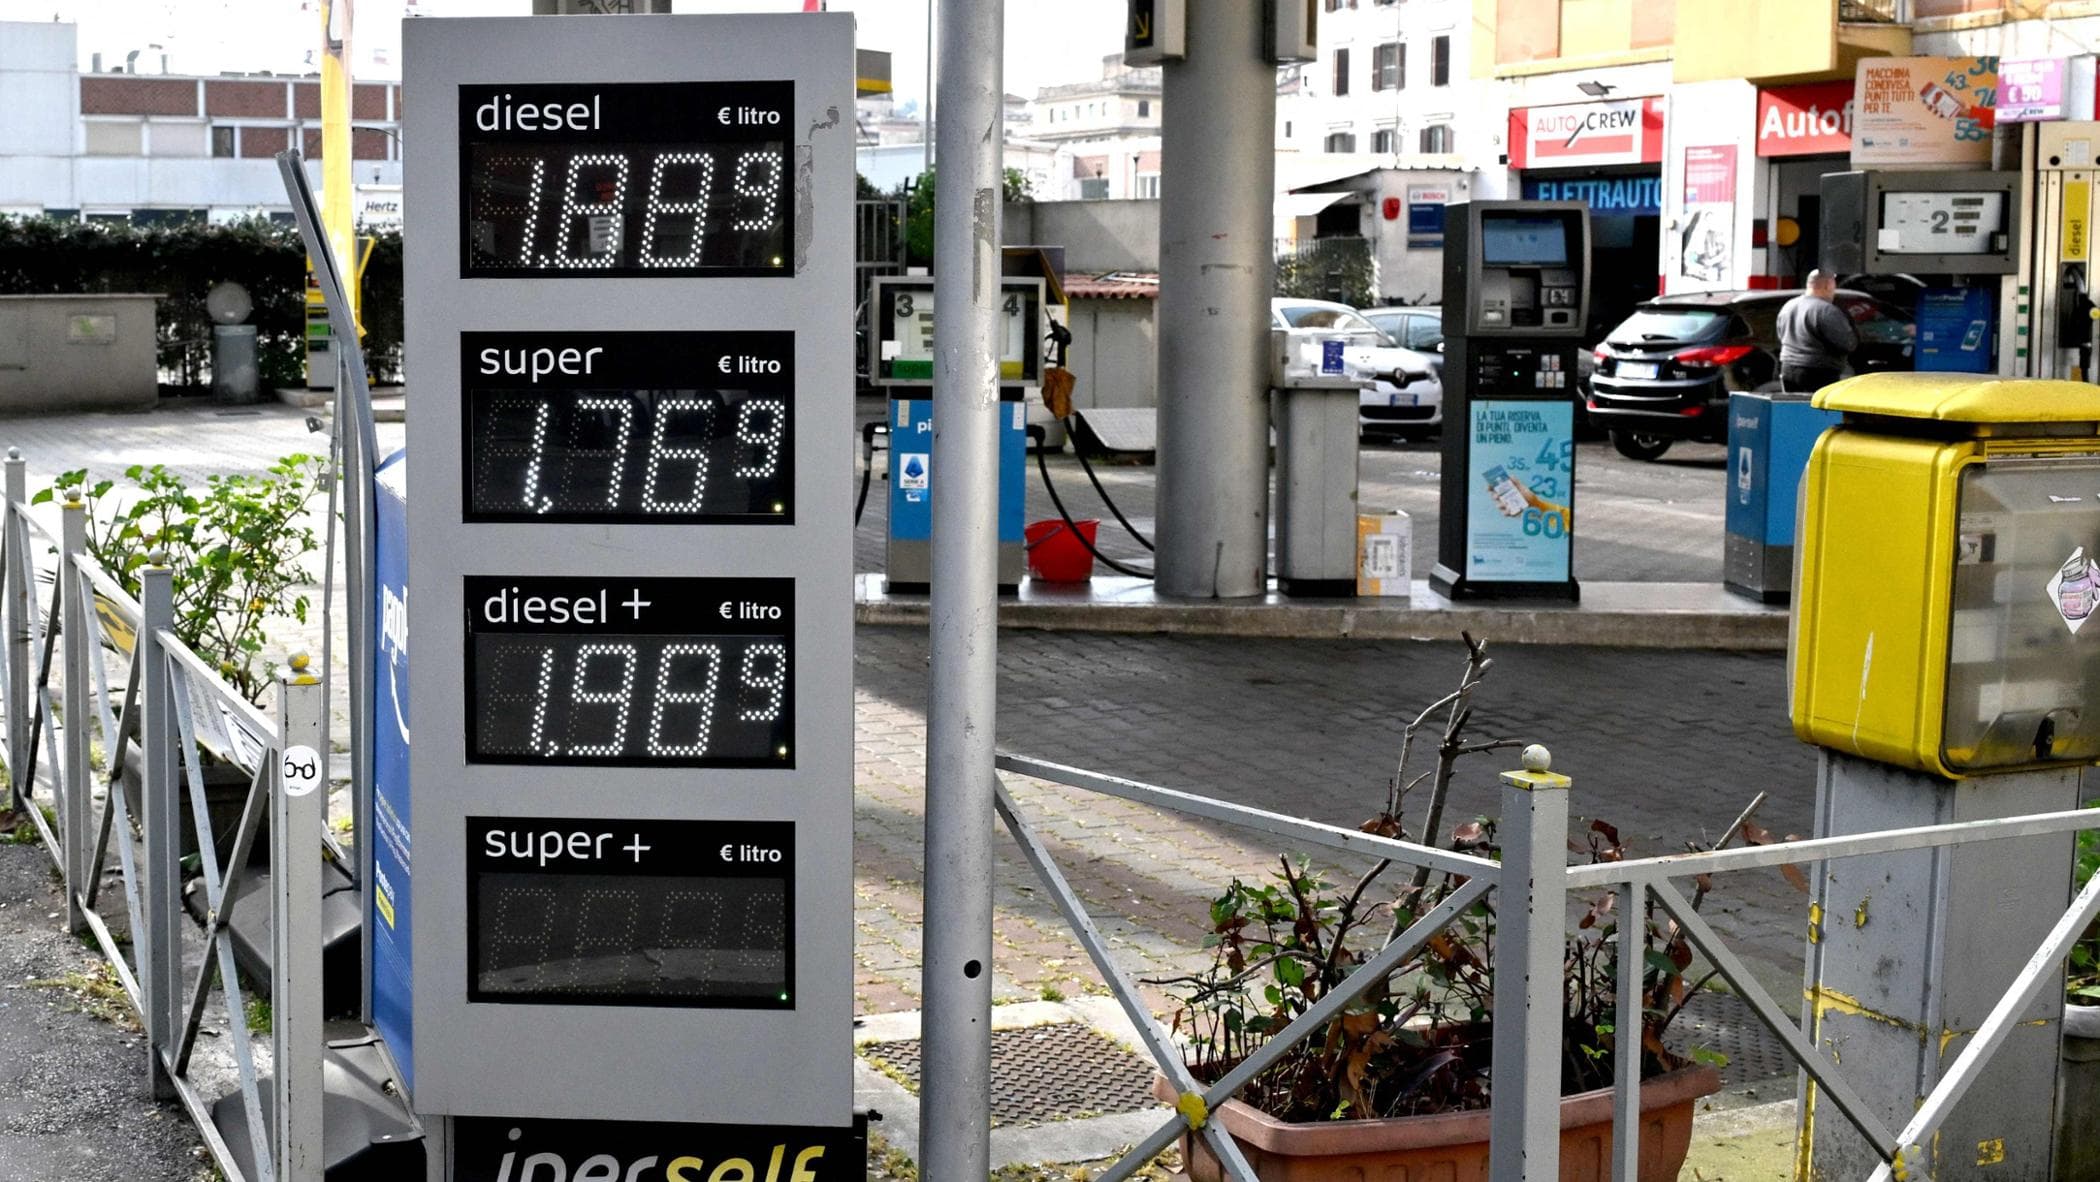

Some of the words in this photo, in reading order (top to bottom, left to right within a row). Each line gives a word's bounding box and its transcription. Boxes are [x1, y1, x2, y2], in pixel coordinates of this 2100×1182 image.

[476, 94, 600, 131] diesel
[717, 107, 731, 125] €
[738, 106, 781, 125] litro
[1536, 115, 1577, 134] AUTO
[1586, 110, 1636, 131] CREW
[365, 200, 398, 212] Hertz
[1931, 210, 1950, 234] 2
[2070, 219, 2082, 256] diesel
[896, 294, 914, 318] 3
[1002, 294, 1020, 317] 4
[480, 347, 603, 383] super
[717, 355, 732, 374] €
[738, 355, 781, 374] litro
[1476, 410, 1488, 421] LA
[1490, 410, 1505, 421] TUA
[1508, 410, 1541, 421] RISERVA
[1476, 433, 1488, 444] UN
[1514, 422, 1548, 433] DIVENTA
[1507, 456, 1526, 471] 35
[1530, 475, 1558, 498] 23
[1522, 507, 1563, 539] 60
[484, 586, 606, 624] diesel
[621, 588, 652, 620] +
[719, 601, 733, 619] €
[740, 601, 782, 619] litro
[485, 829, 613, 866] super
[622, 833, 651, 863] +
[720, 844, 733, 862] €
[740, 844, 782, 862] litro
